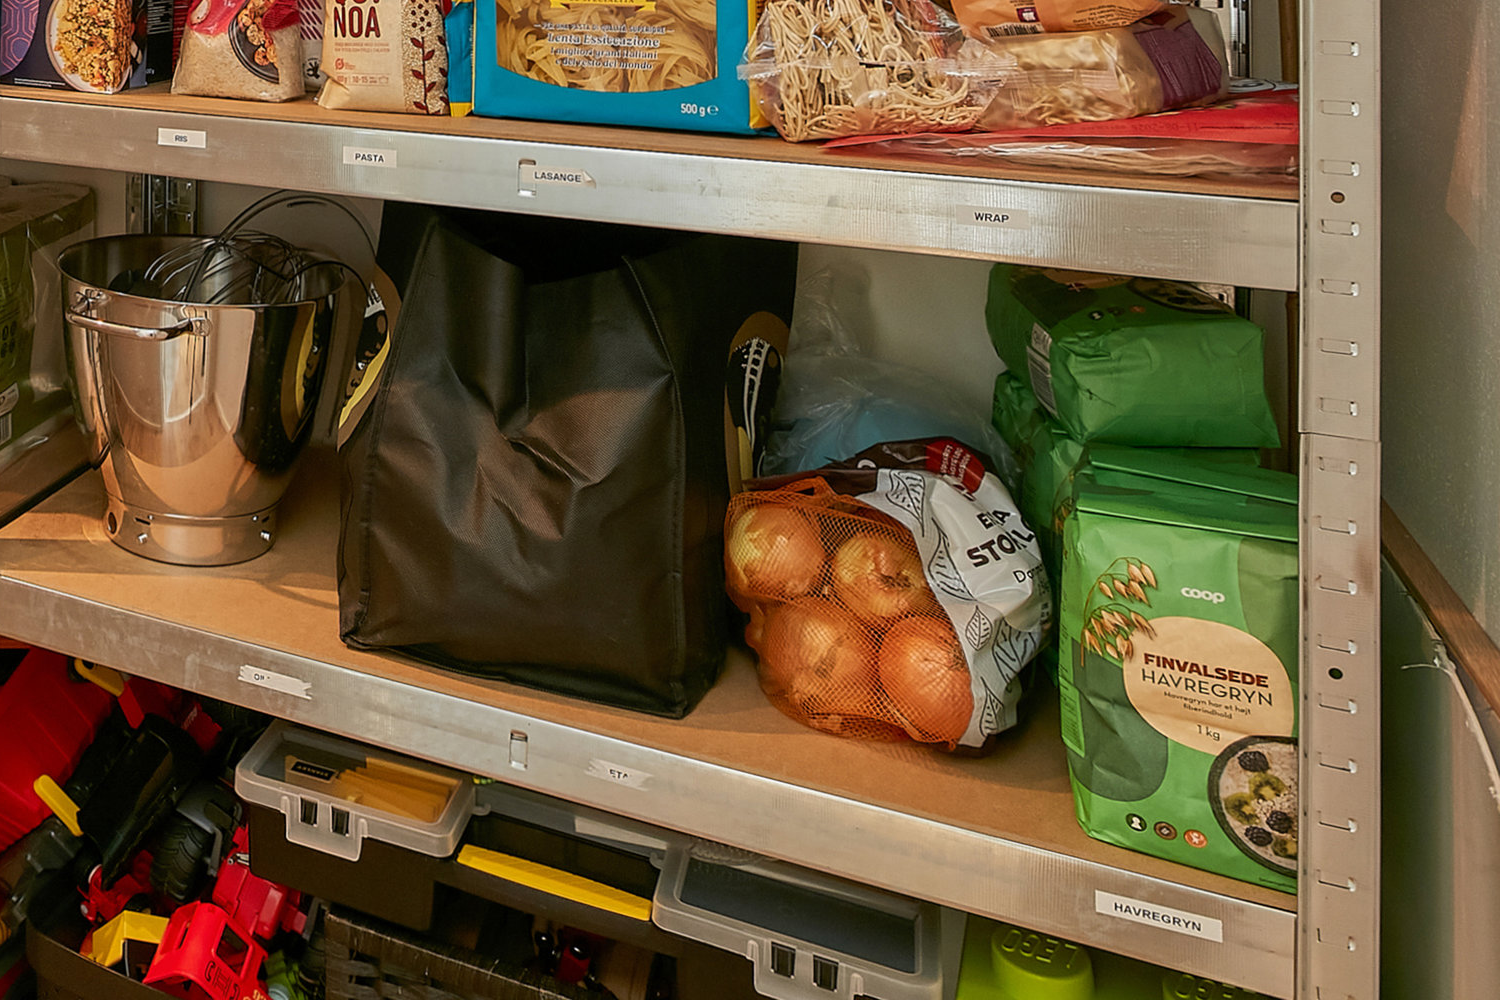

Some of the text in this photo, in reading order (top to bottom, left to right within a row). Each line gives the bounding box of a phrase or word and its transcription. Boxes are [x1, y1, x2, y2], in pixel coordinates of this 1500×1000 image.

[334, 5, 381, 38] NOA
[620, 61, 652, 70] mondo
[681, 103, 706, 116] 500 g
[174, 134, 188, 142] RIS
[355, 152, 384, 163] PASTA
[533, 171, 582, 183] LASANGE
[974, 212, 1010, 223] WRAP
[1181, 587, 1226, 604] coop
[1143, 652, 1269, 688] FINVALSEDE
[1141, 668, 1273, 707] HAVREGRYN
[1205, 726, 1220, 741] kg
[1113, 901, 1202, 933] HAVREGRYN
